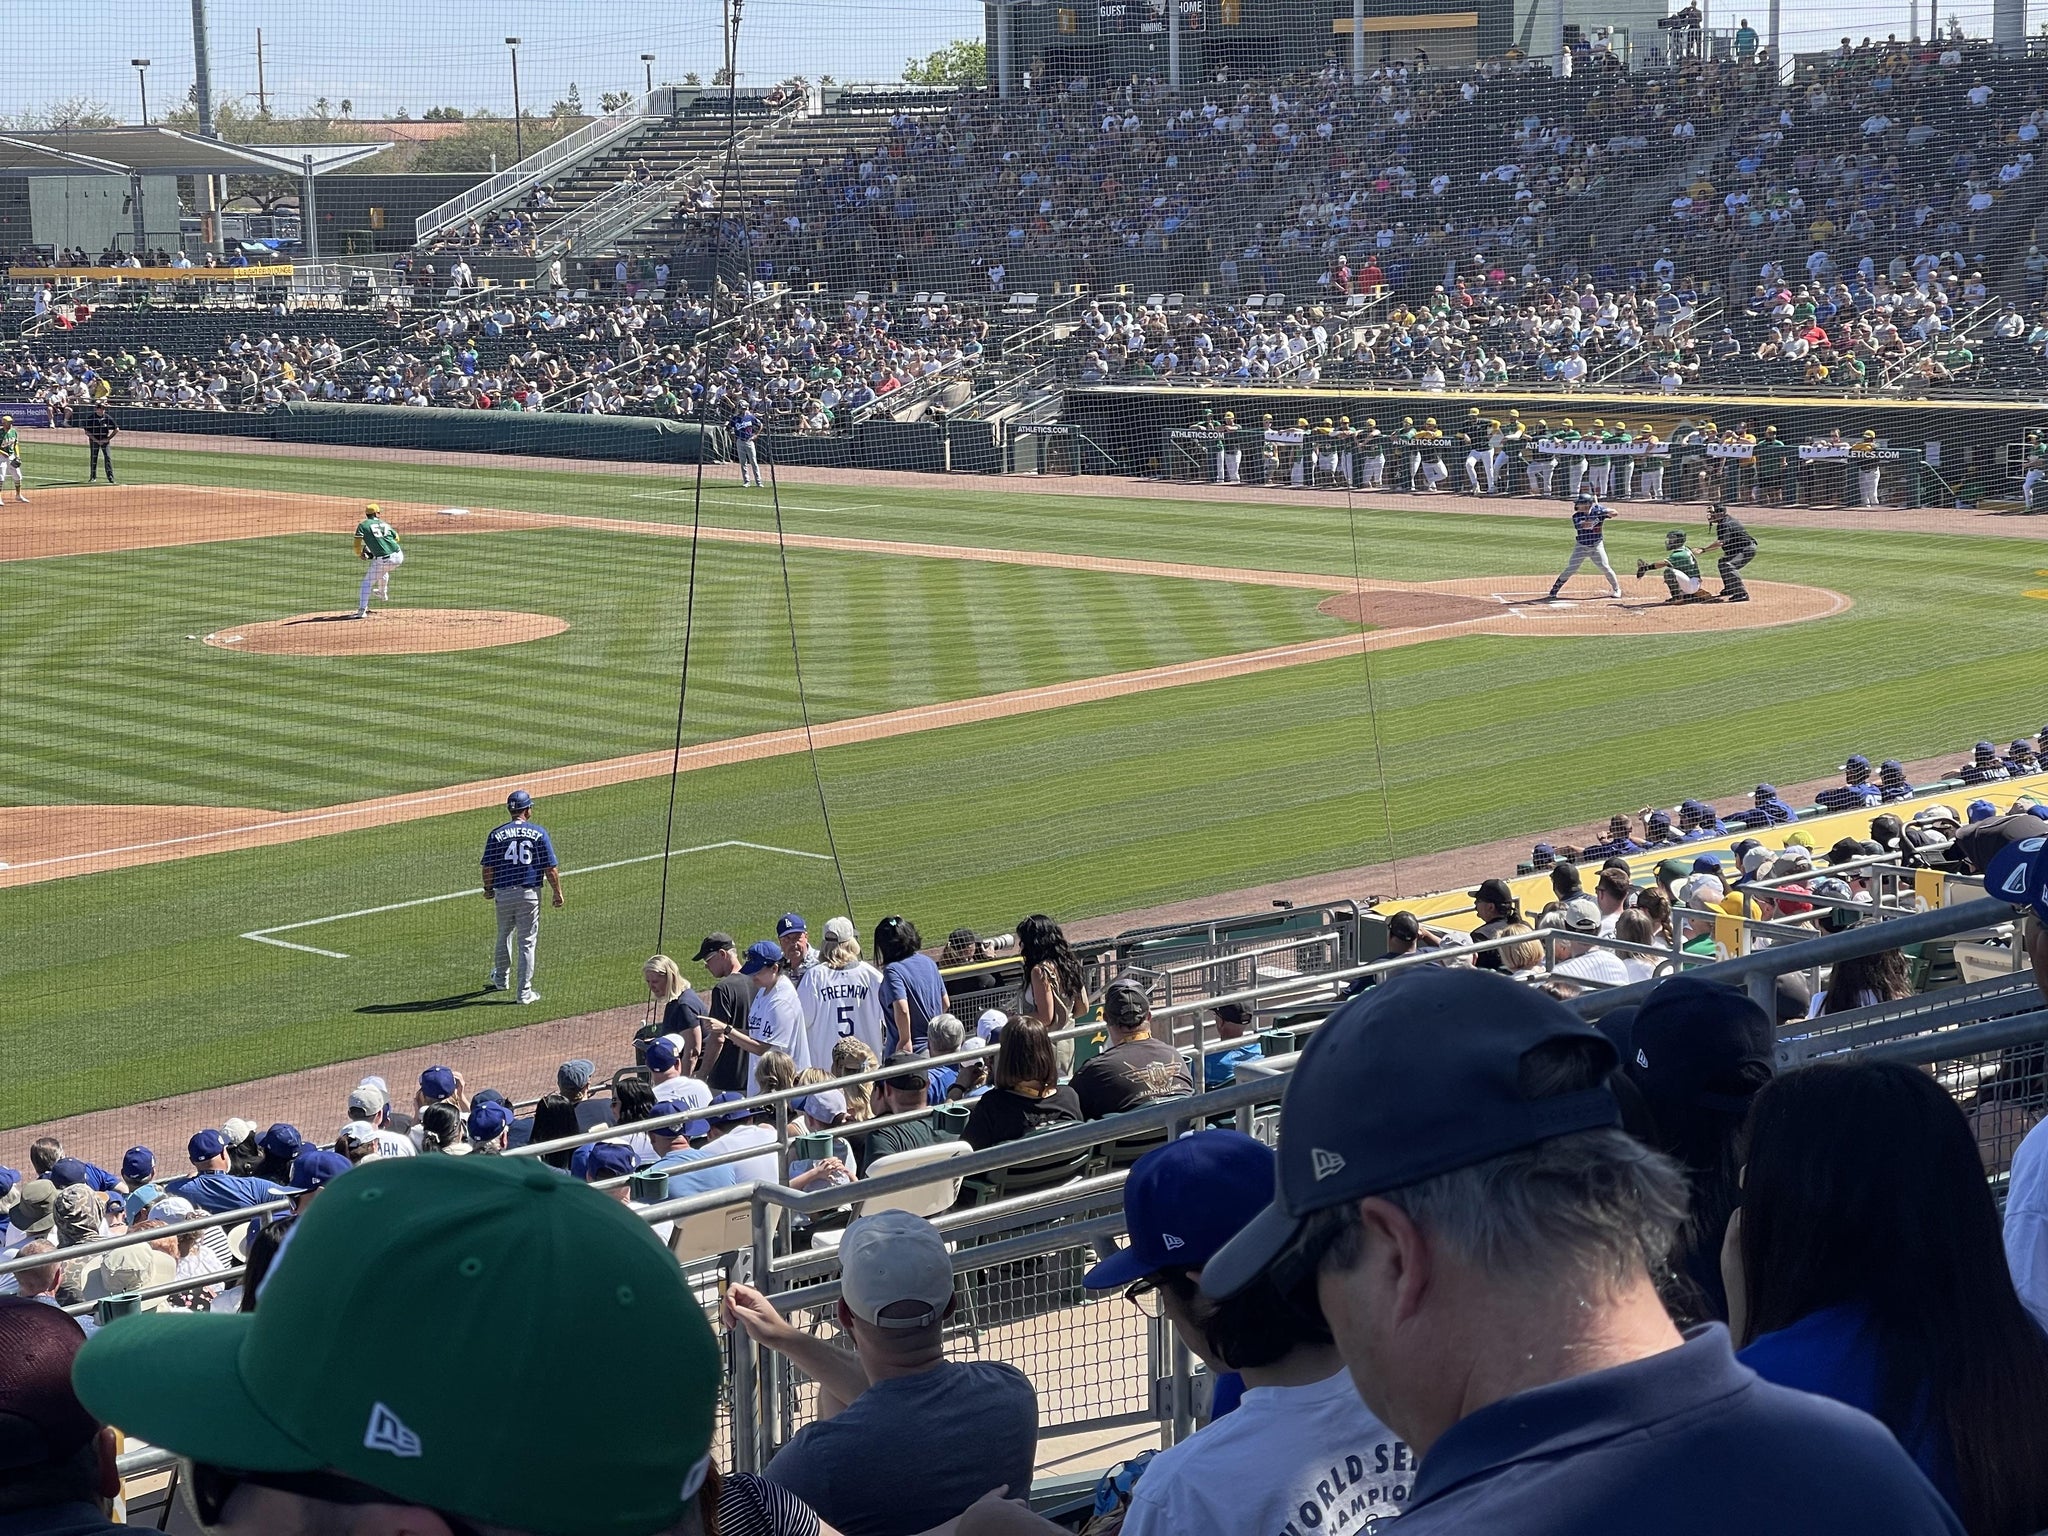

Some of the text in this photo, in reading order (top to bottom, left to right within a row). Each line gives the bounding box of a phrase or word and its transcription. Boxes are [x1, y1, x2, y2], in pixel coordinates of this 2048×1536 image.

[1100, 5, 1126, 17] GUEST
[1140, 22, 1162, 32] INNING
[26, 408, 48, 416] Health
[1017, 425, 1069, 434] ATHLETICS.COM
[1170, 430, 1225, 439] ATHLETICS.COM
[1846, 450, 1900, 459] LETICS.COM
[495, 827, 543, 842] HENNESSEY
[504, 840, 533, 865] 46
[820, 984, 869, 1001] FREEMAN
[837, 1006, 854, 1038] 5
